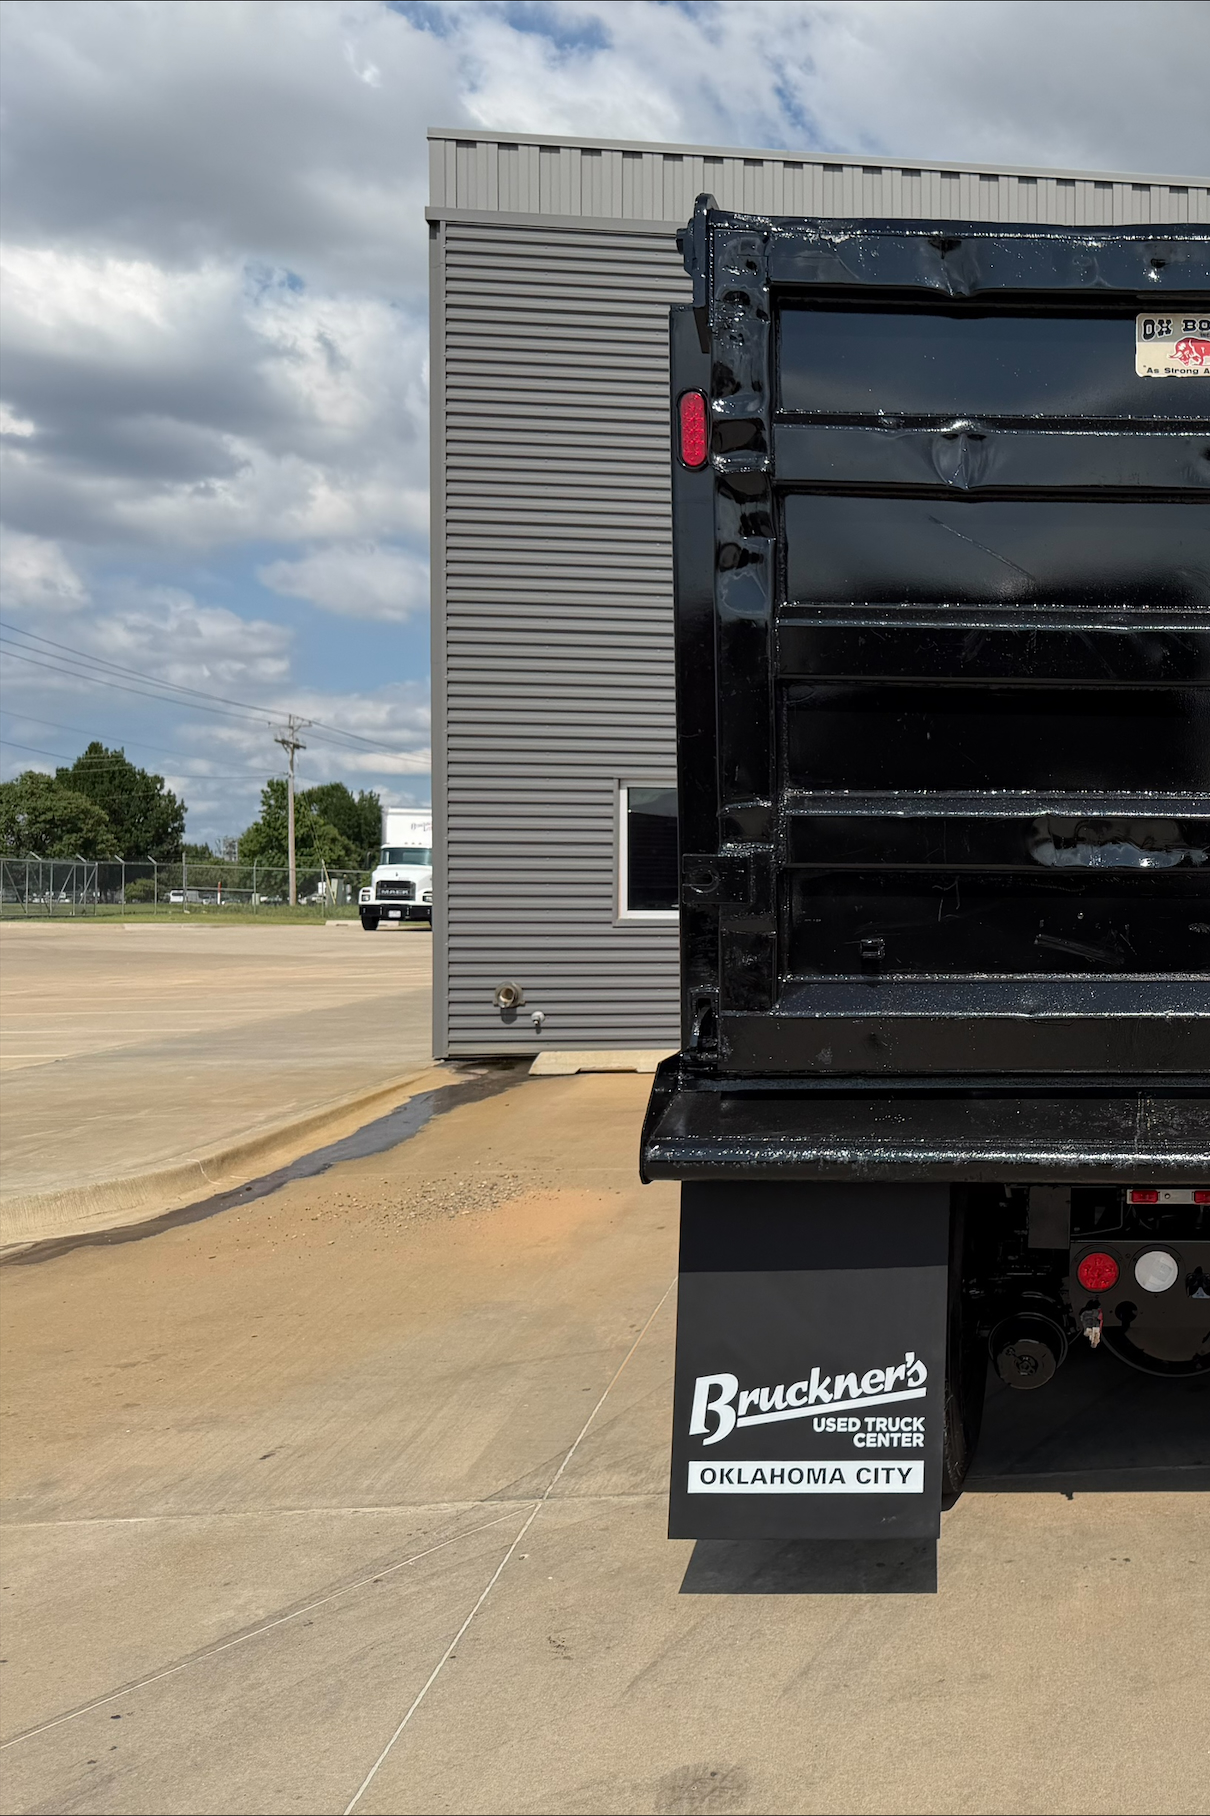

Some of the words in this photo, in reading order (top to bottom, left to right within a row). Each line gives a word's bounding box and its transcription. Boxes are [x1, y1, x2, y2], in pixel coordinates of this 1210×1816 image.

[1142, 318, 1173, 340] OX
[1164, 367, 1199, 375] Strong
[689, 1351, 928, 1446] Bruckner's
[812, 1417, 861, 1432] USED
[864, 1416, 925, 1432] TRUCK
[853, 1433, 925, 1448] CENTER
[699, 1467, 846, 1485] OKLAHOMA
[856, 1467, 913, 1485] CITY
